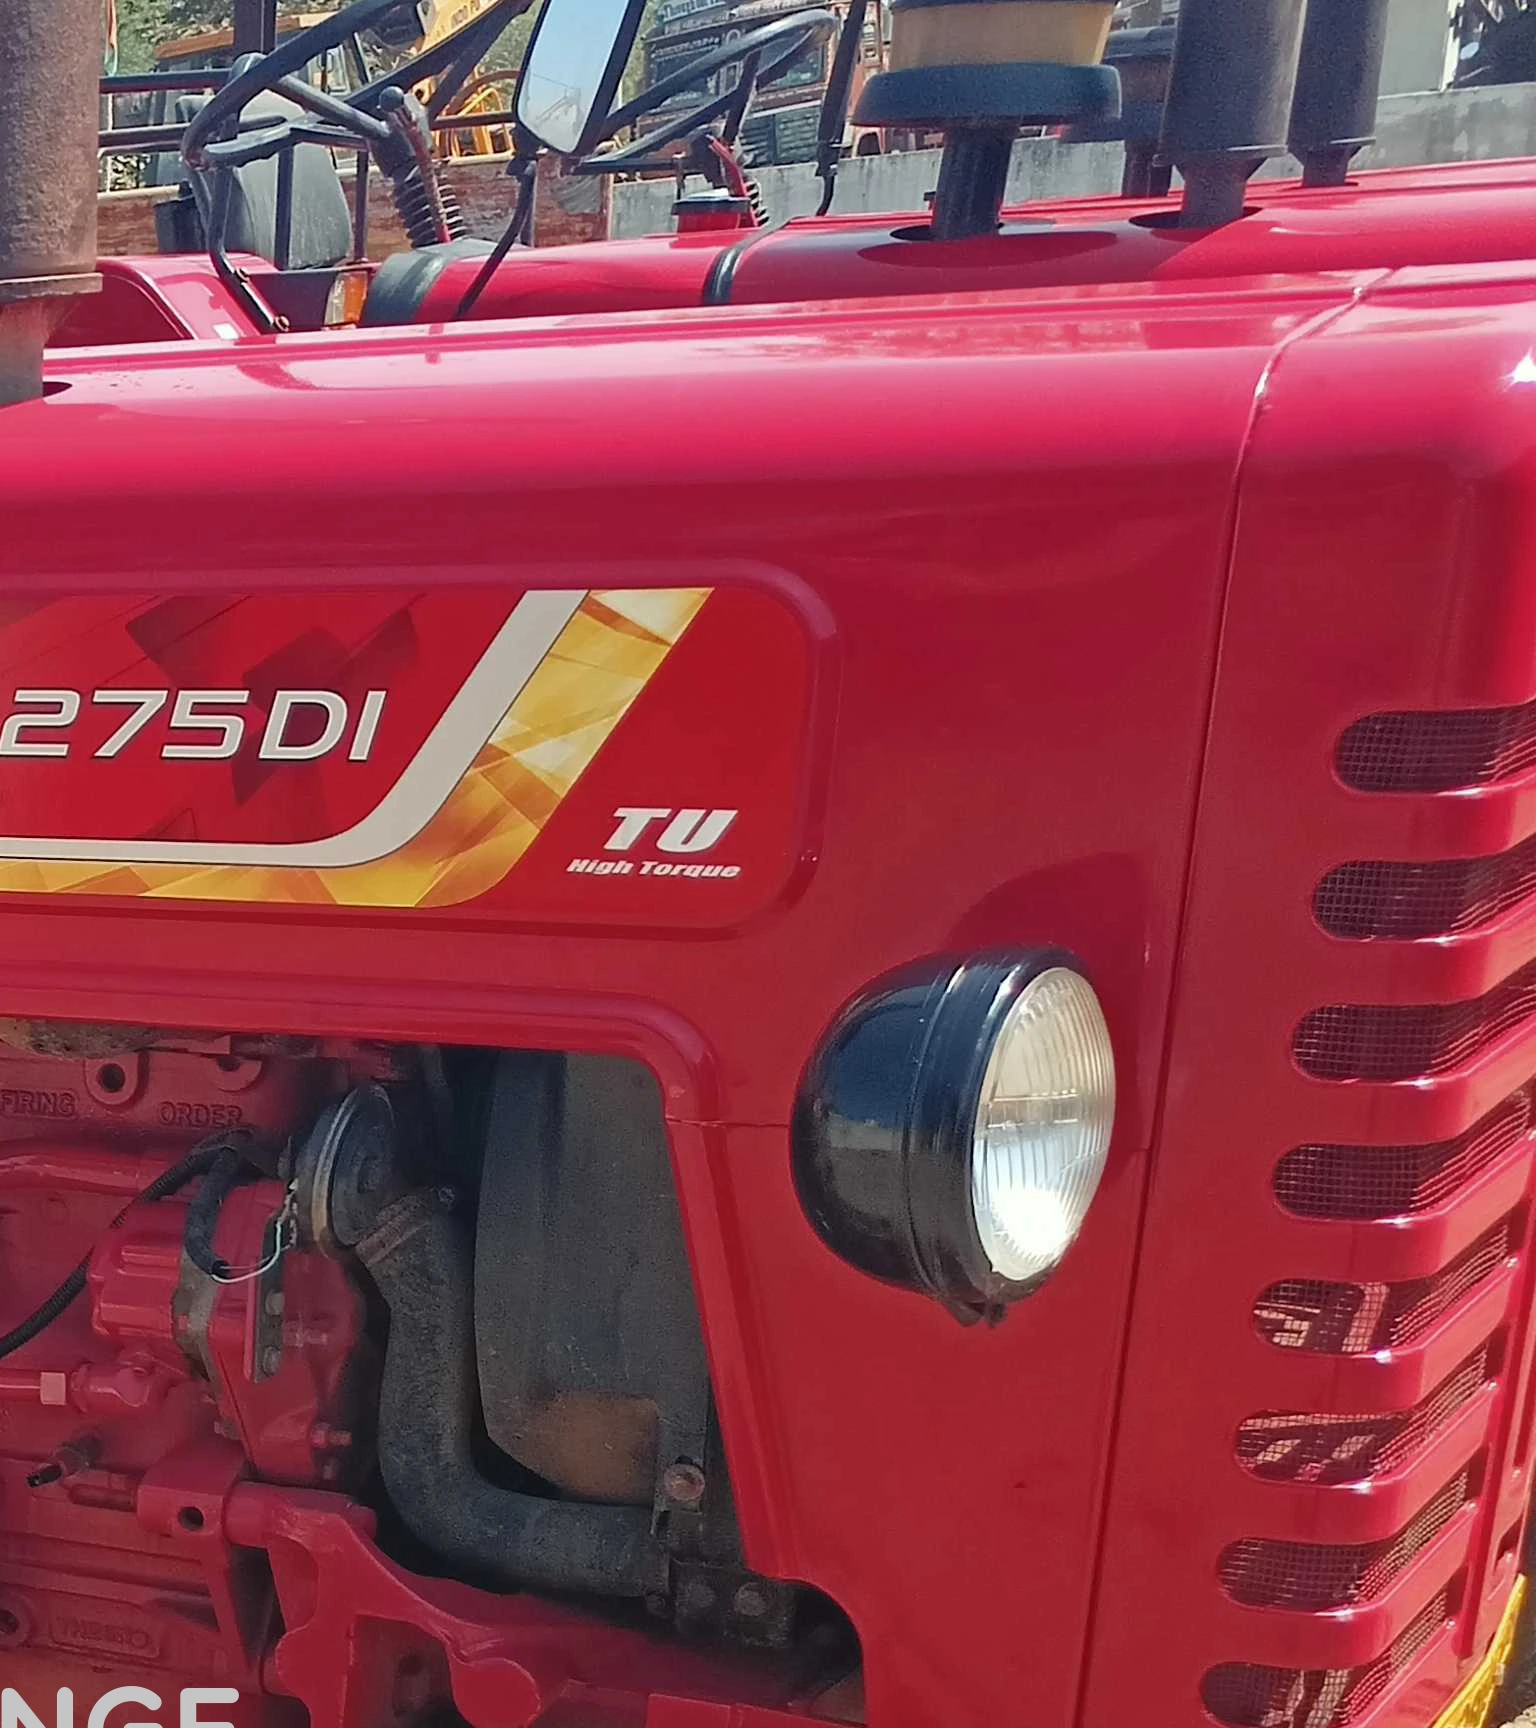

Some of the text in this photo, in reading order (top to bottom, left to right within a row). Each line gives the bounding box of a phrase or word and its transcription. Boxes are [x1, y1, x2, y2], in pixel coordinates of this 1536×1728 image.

[604, 806, 739, 853] TU
[566, 858, 741, 879] High Torque
[159, 1100, 244, 1128] ORDER
